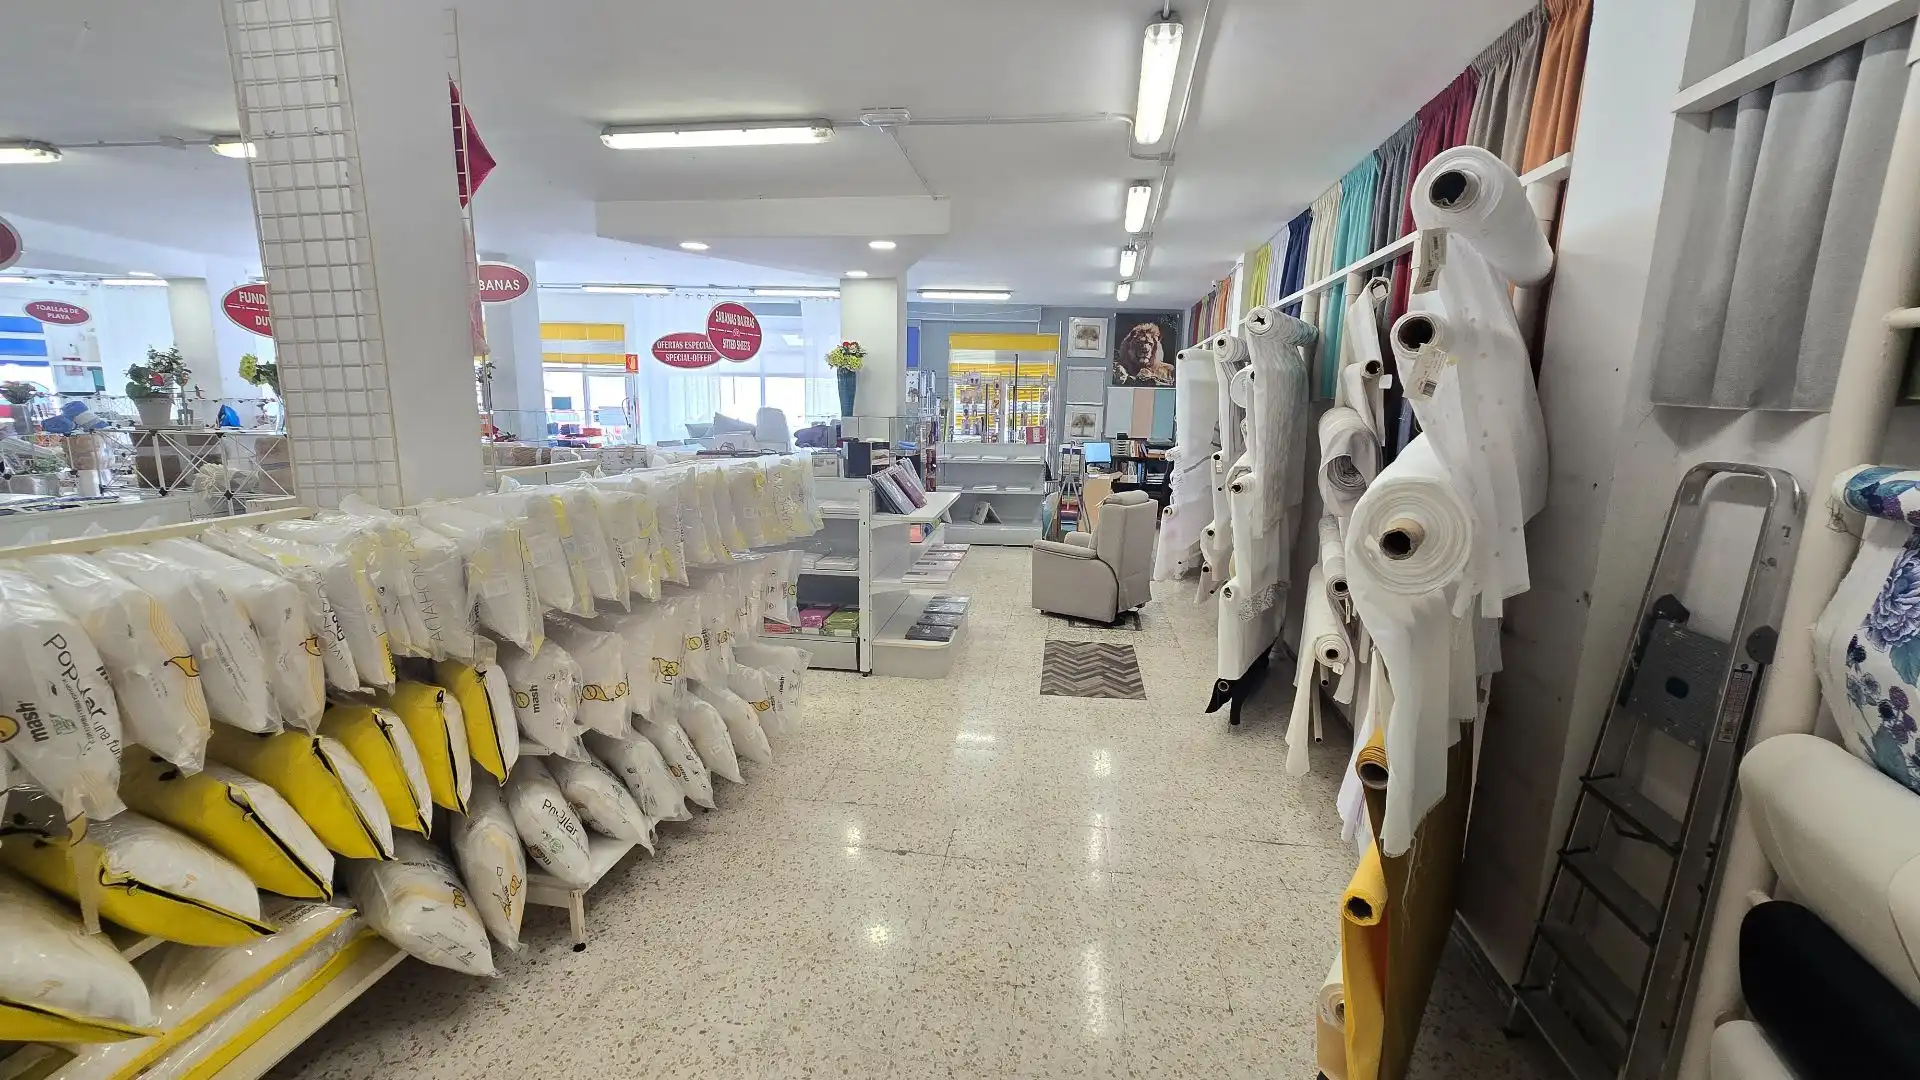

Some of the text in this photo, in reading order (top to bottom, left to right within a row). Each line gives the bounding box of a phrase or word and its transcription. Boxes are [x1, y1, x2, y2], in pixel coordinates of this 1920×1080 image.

[239, 291, 269, 306] FUND
[35, 304, 69, 314] TOALLAS
[47, 312, 71, 320] PLAYA
[656, 340, 683, 350] OFERTAS
[736, 340, 751, 352] SHEETS
[665, 353, 712, 362] SPECIAL-OFFER
[529, 683, 543, 714] mash
[16, 701, 50, 743] mash
